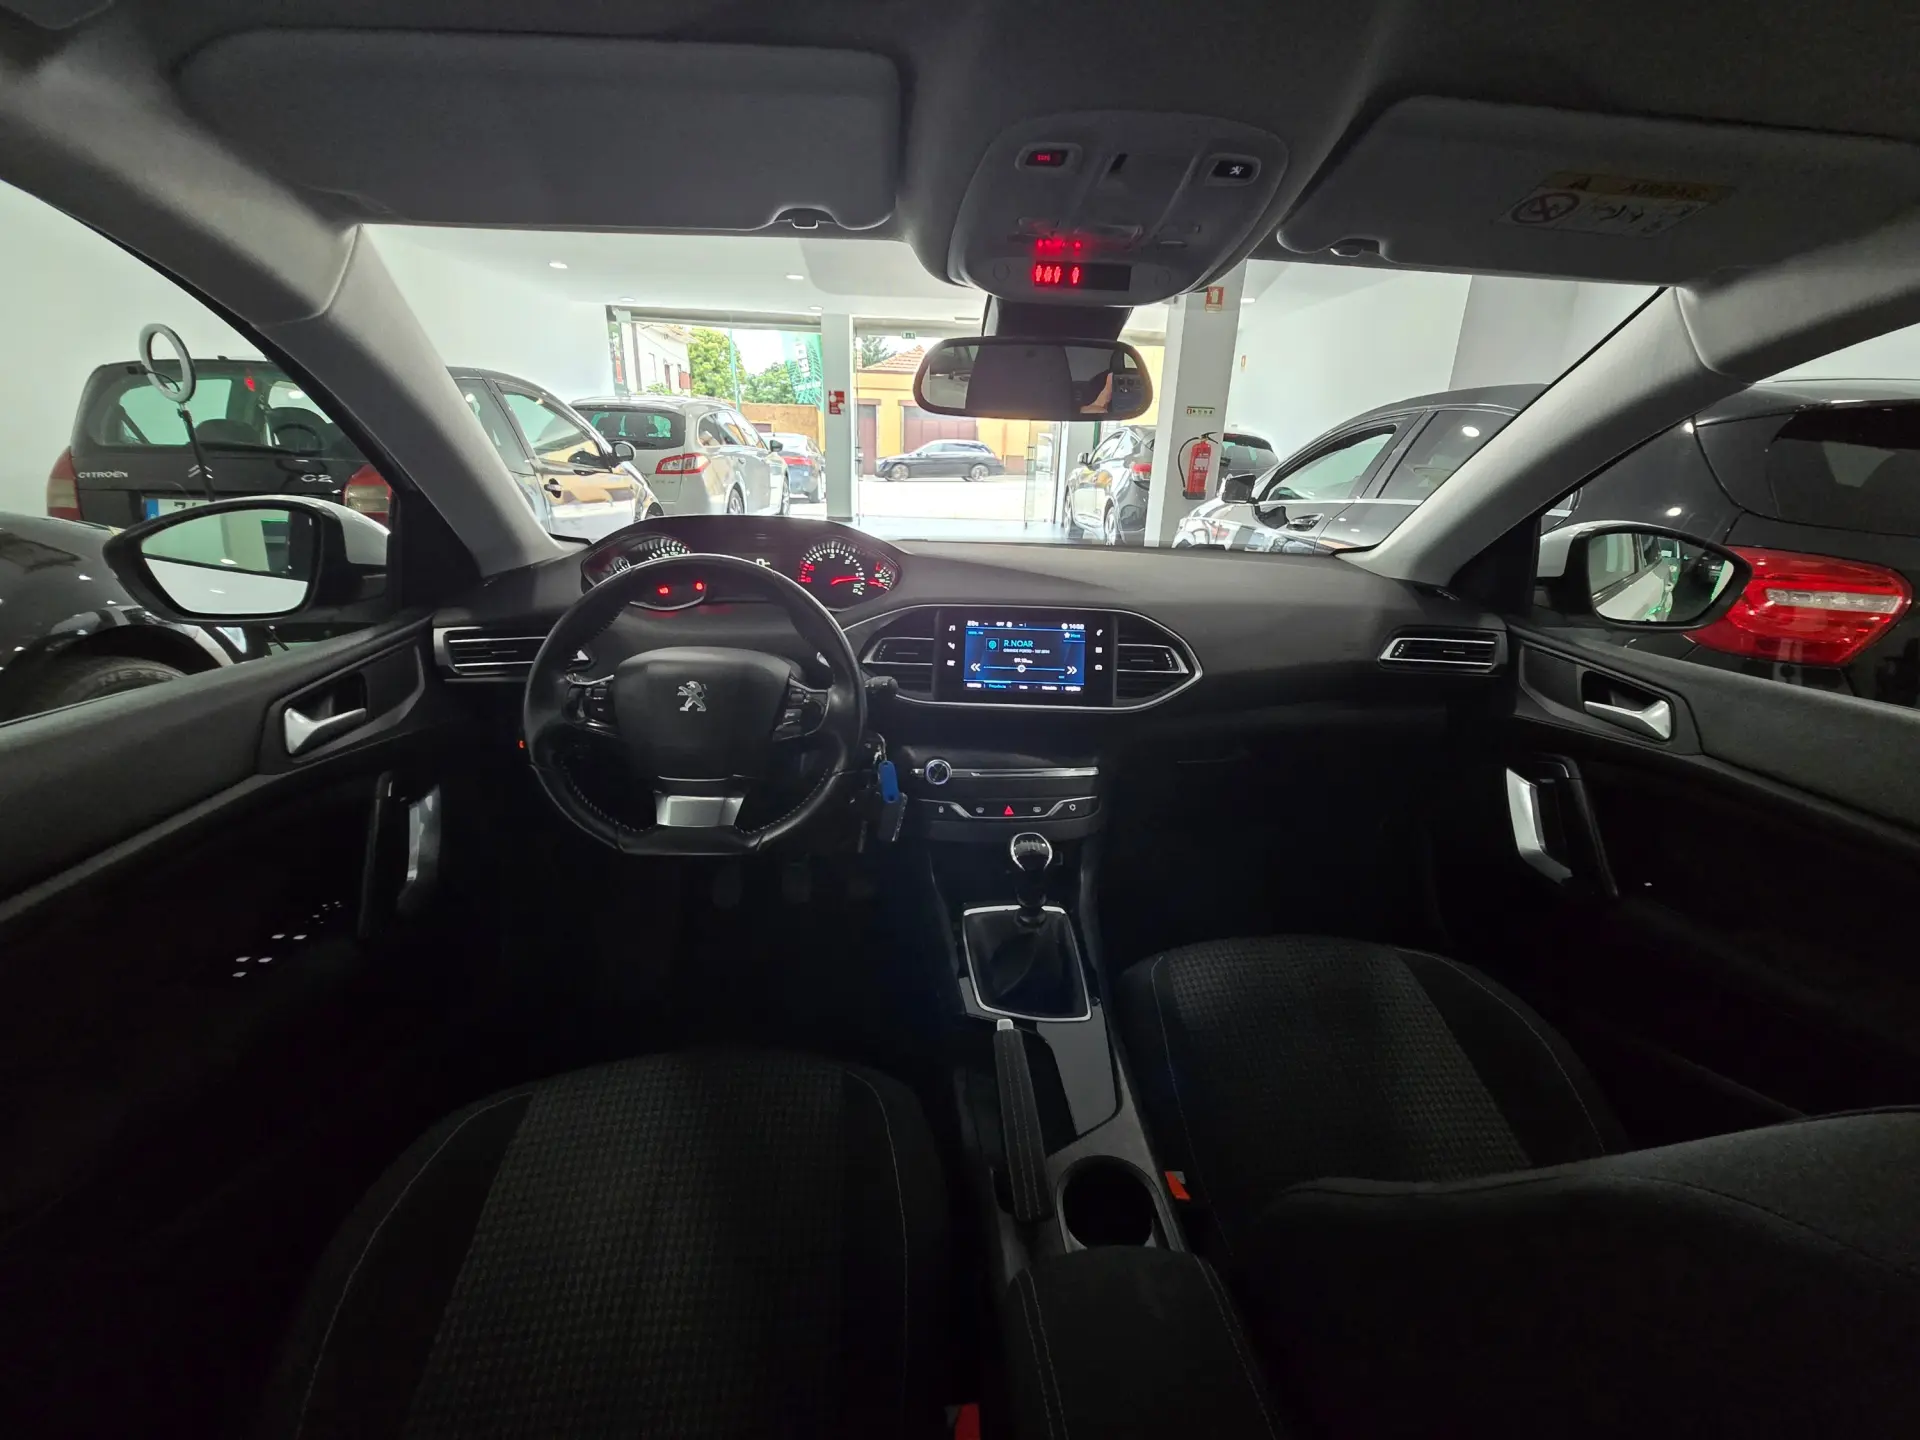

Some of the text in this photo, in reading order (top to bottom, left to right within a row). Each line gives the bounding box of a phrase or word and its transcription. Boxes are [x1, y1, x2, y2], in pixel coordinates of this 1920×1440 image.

[300, 474, 335, 483] C2
[1003, 639, 1034, 648] R.NOAR
[97, 669, 175, 687] NEXE
